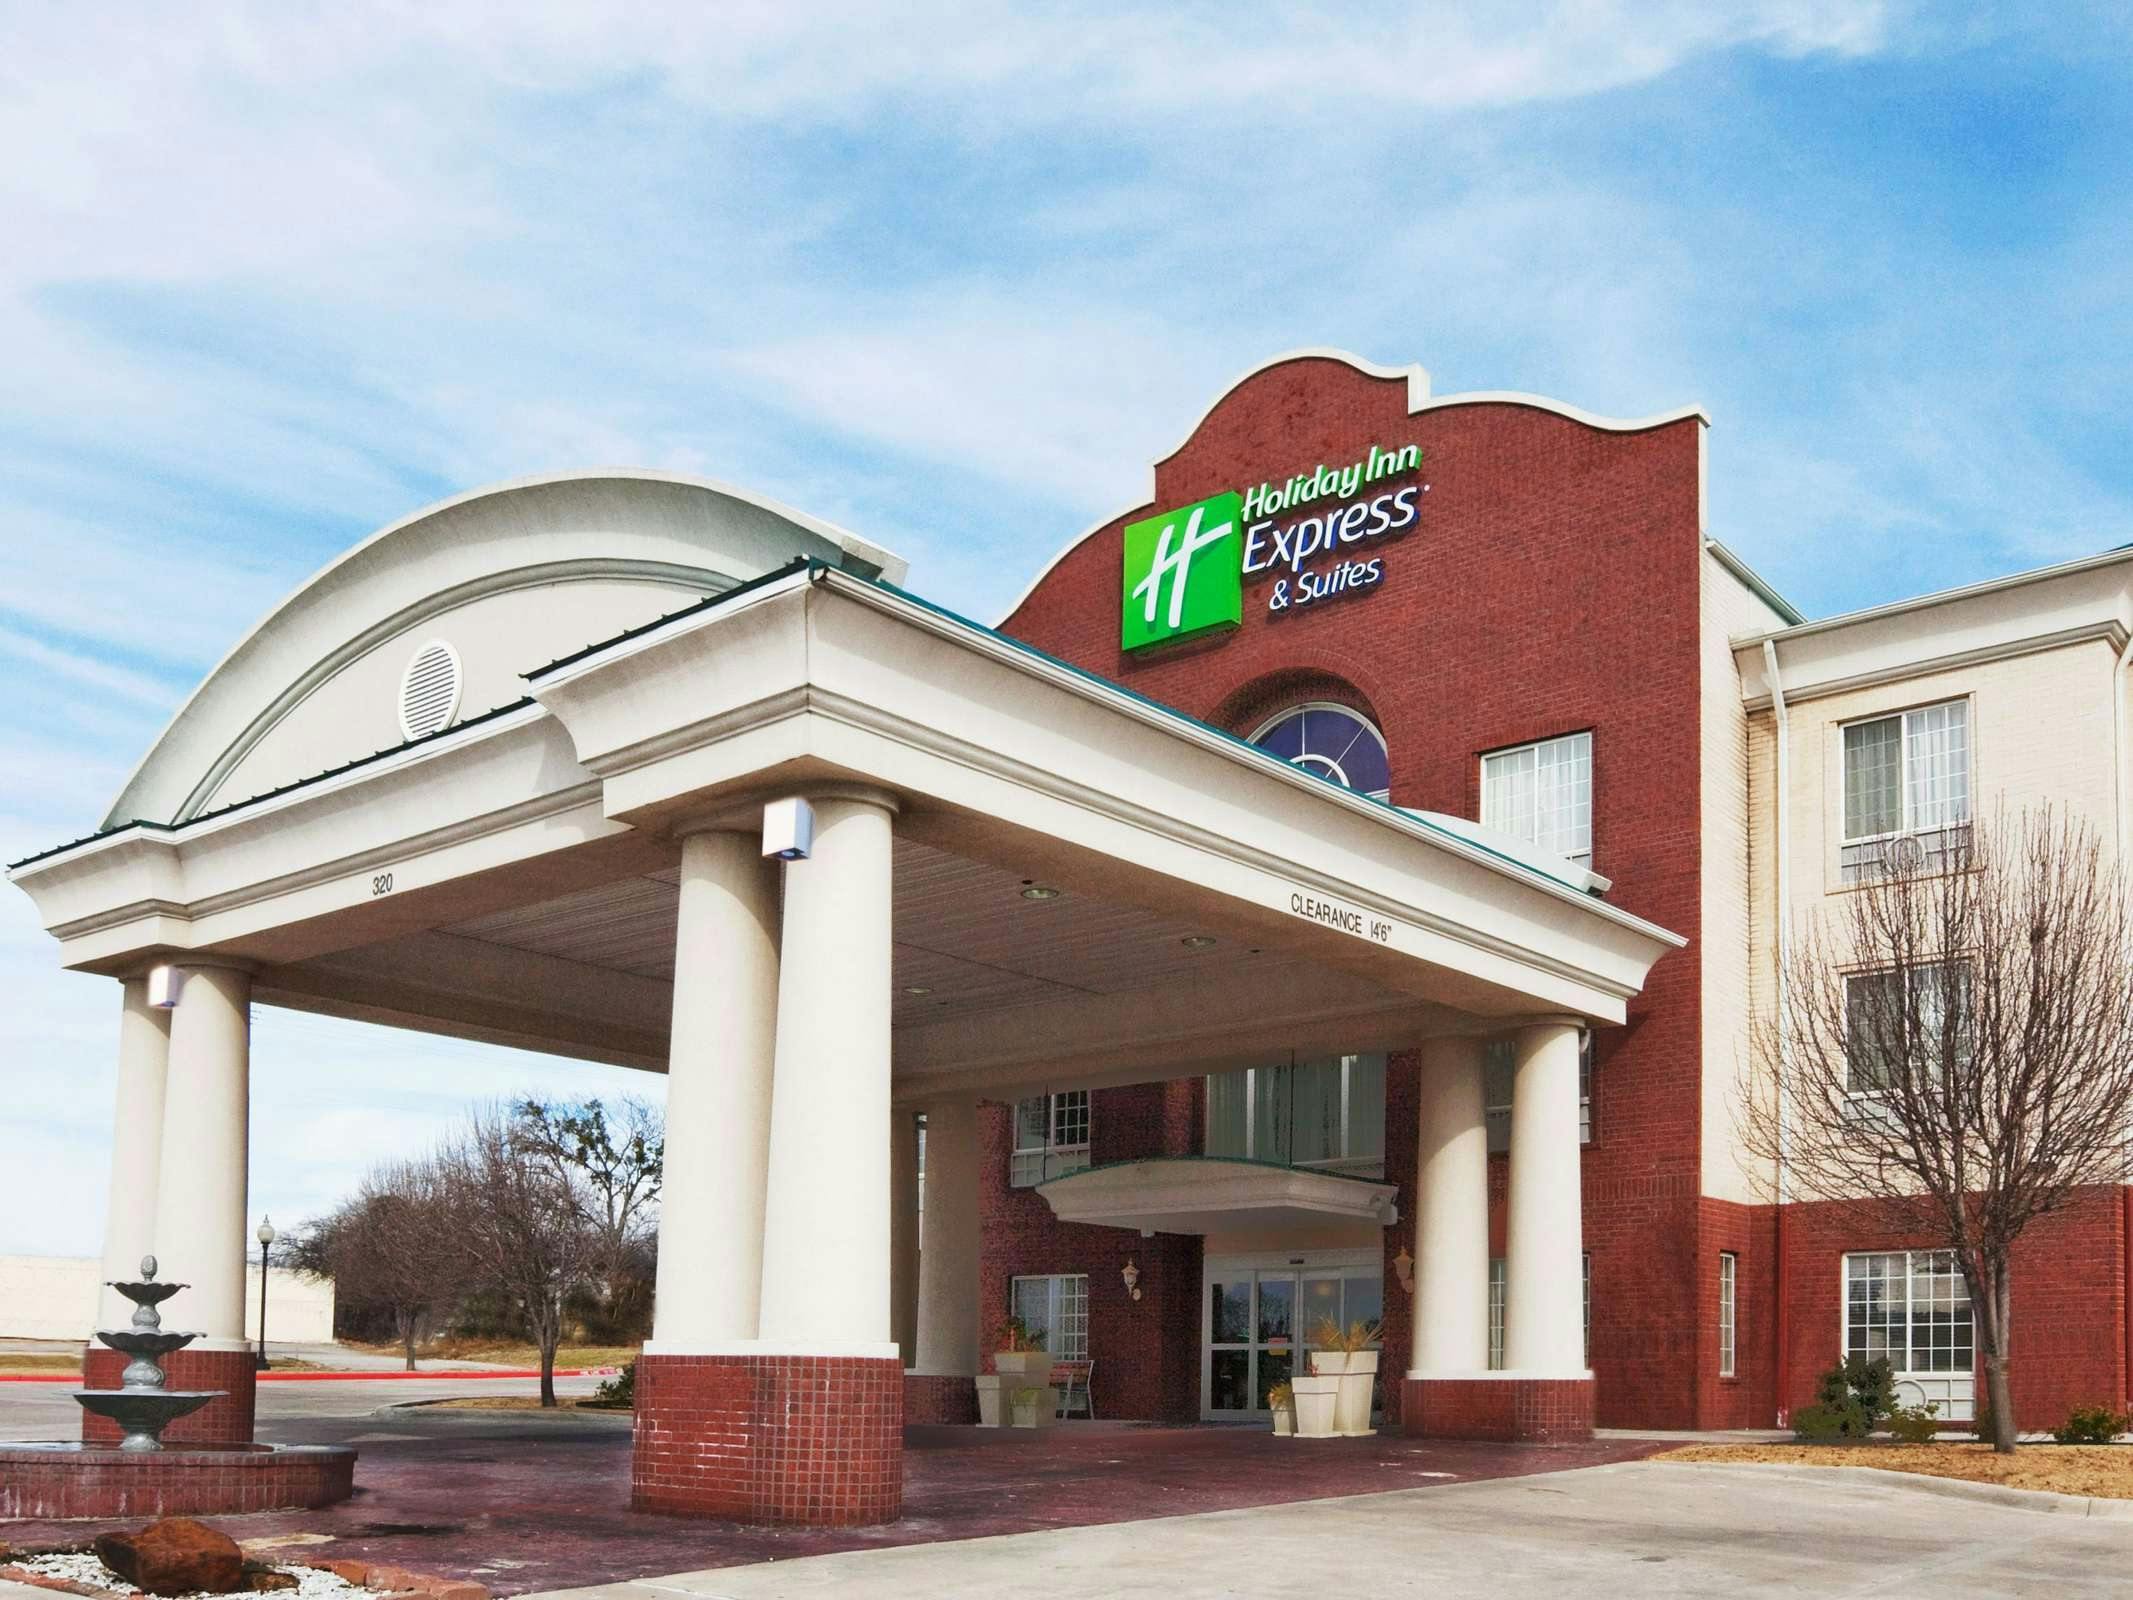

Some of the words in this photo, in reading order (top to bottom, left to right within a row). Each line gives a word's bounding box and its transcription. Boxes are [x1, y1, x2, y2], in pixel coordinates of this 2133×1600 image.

[1241, 463, 1364, 522] Holiday
[1365, 445, 1420, 482] Inn
[1242, 486, 1418, 574] Express
[1269, 579, 1289, 611] &
[1295, 558, 1382, 604] Suites
[372, 872, 393, 896] 320
[1290, 893, 1362, 935] CLEARANCE
